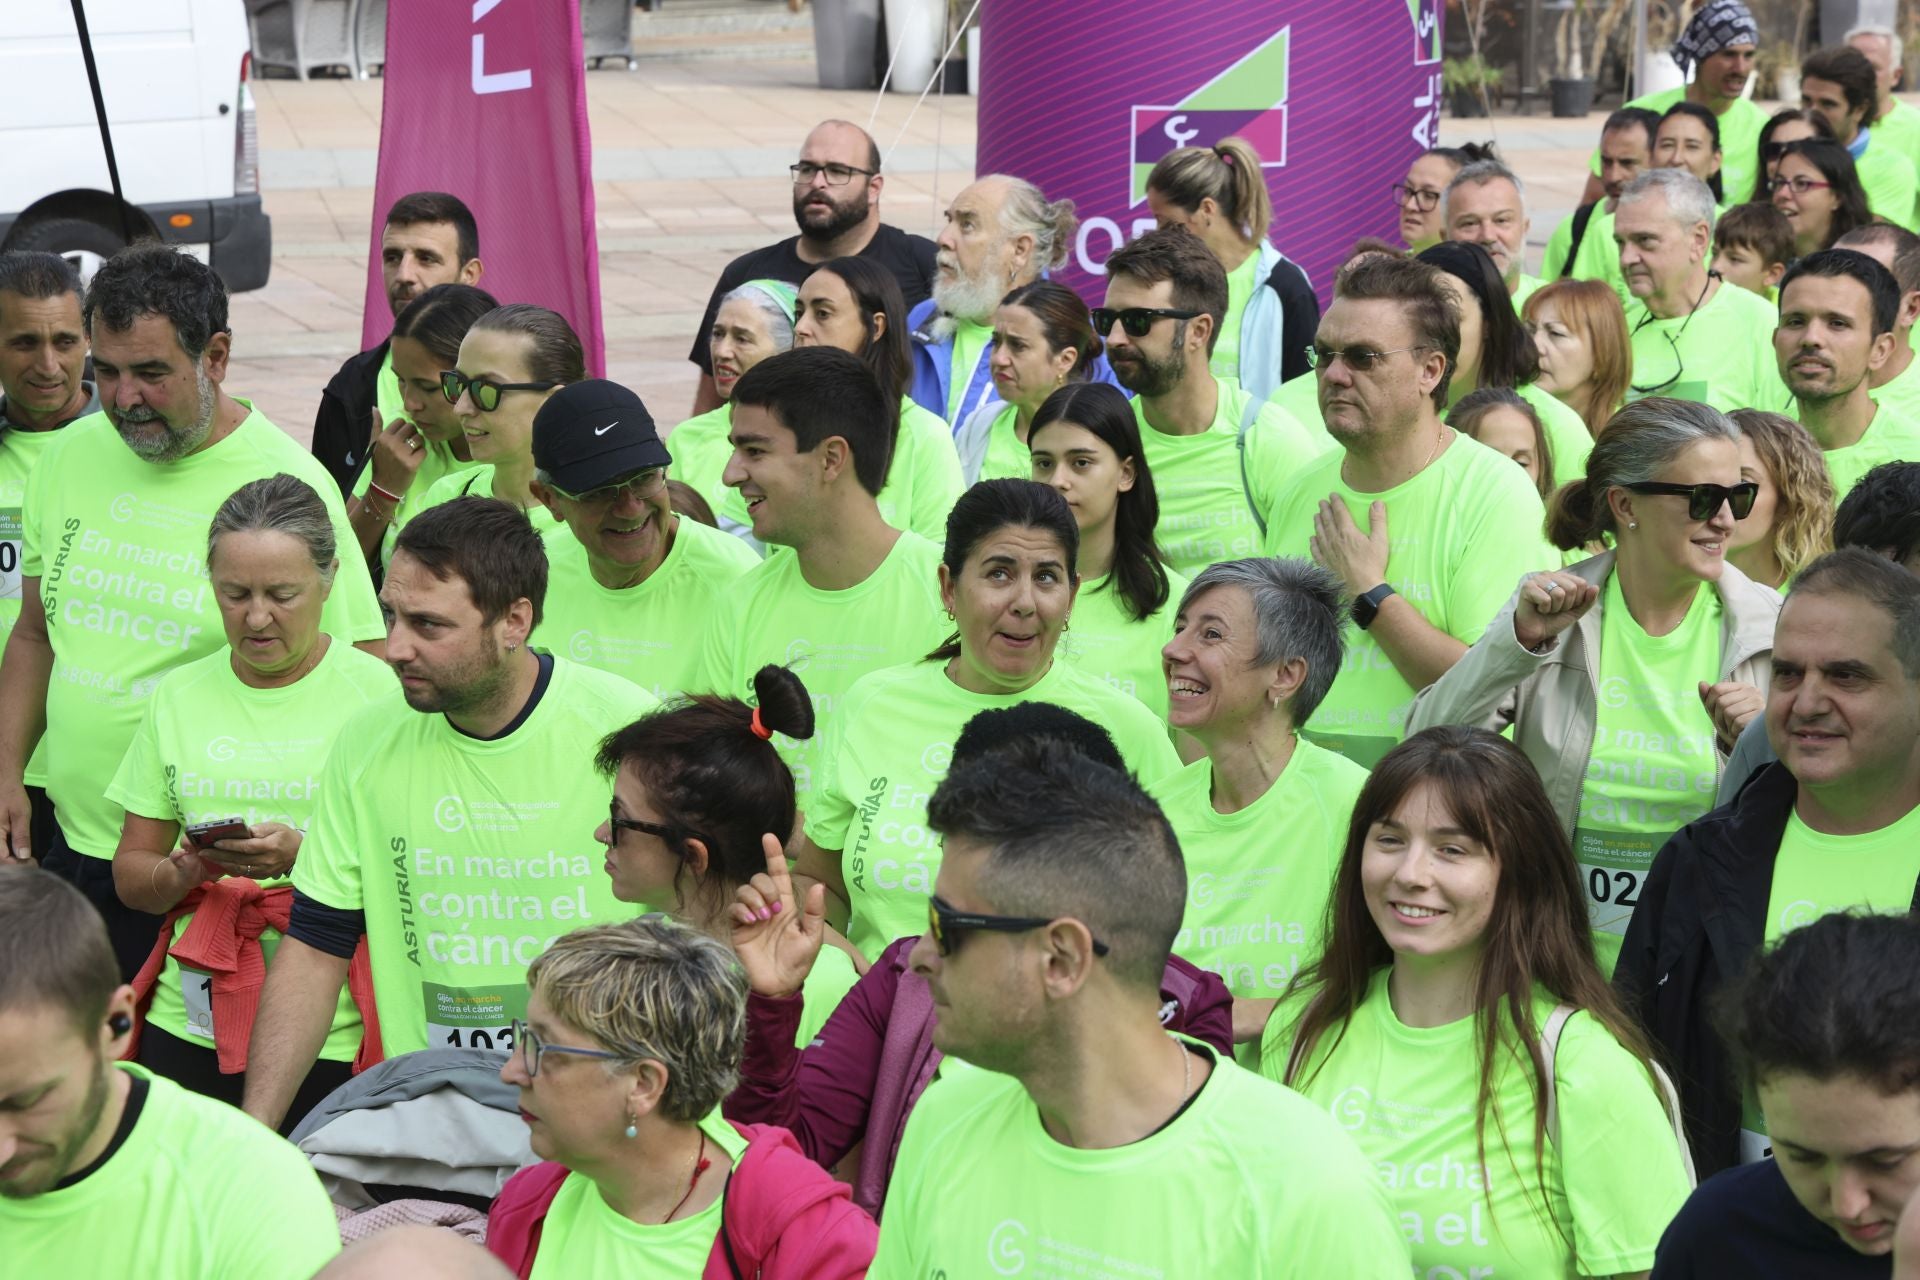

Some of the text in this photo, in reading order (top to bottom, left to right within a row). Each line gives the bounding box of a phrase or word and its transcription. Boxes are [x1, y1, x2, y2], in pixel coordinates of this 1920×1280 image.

[79, 529, 112, 557] En
[44, 517, 81, 627] ASTURIAS
[67, 564, 207, 615] contra el
[63, 596, 202, 651] cáncer
[181, 771, 215, 798] En
[852, 776, 889, 893] ASTURIAS
[1583, 845, 1652, 858] contra el cáncer
[415, 848, 592, 879] En marcha
[390, 836, 422, 968] ASTURIAS
[418, 885, 593, 921] contra el
[438, 1004, 503, 1013] contra el cáncer
[1434, 1201, 1489, 1248] el
